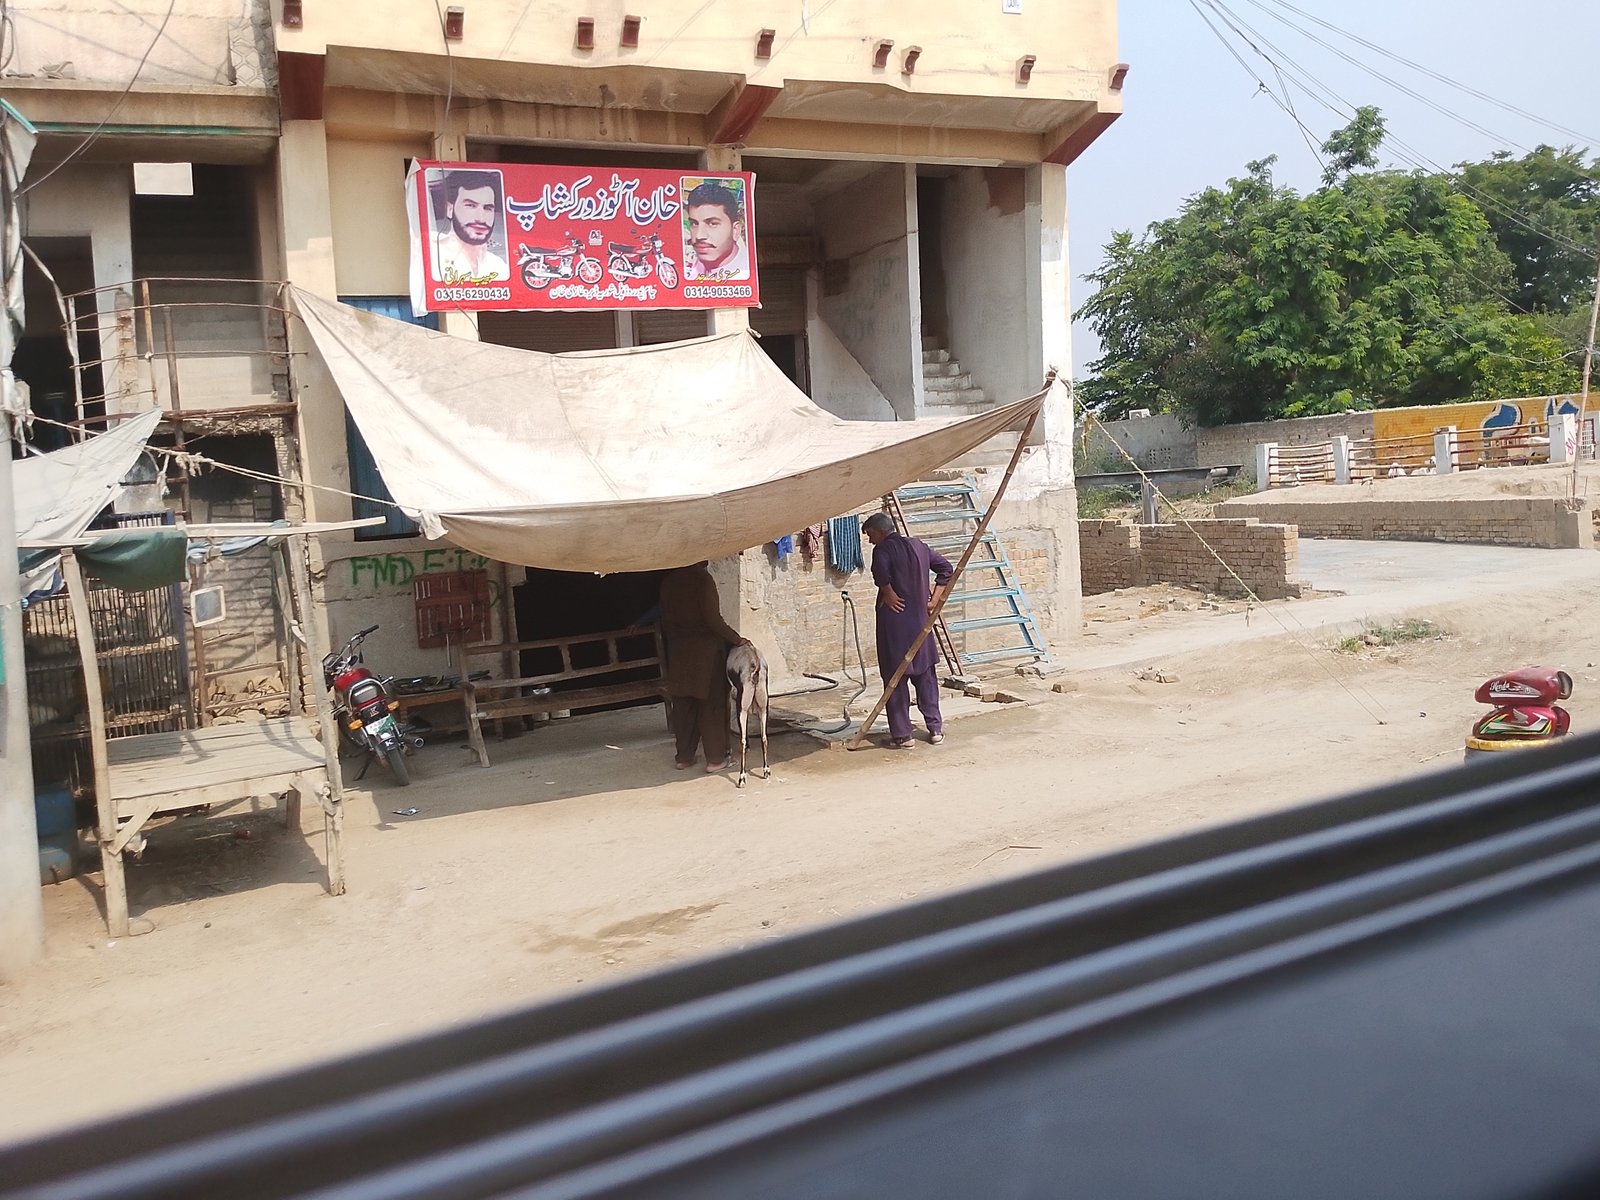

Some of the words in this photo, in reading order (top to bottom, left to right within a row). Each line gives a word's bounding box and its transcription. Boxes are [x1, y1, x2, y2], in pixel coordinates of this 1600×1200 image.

[506, 175, 597, 231] ورکشاپ
[631, 183, 680, 226] خان
[434, 287, 511, 301] 0315-6290434
[684, 285, 753, 299] 0314-9053466
